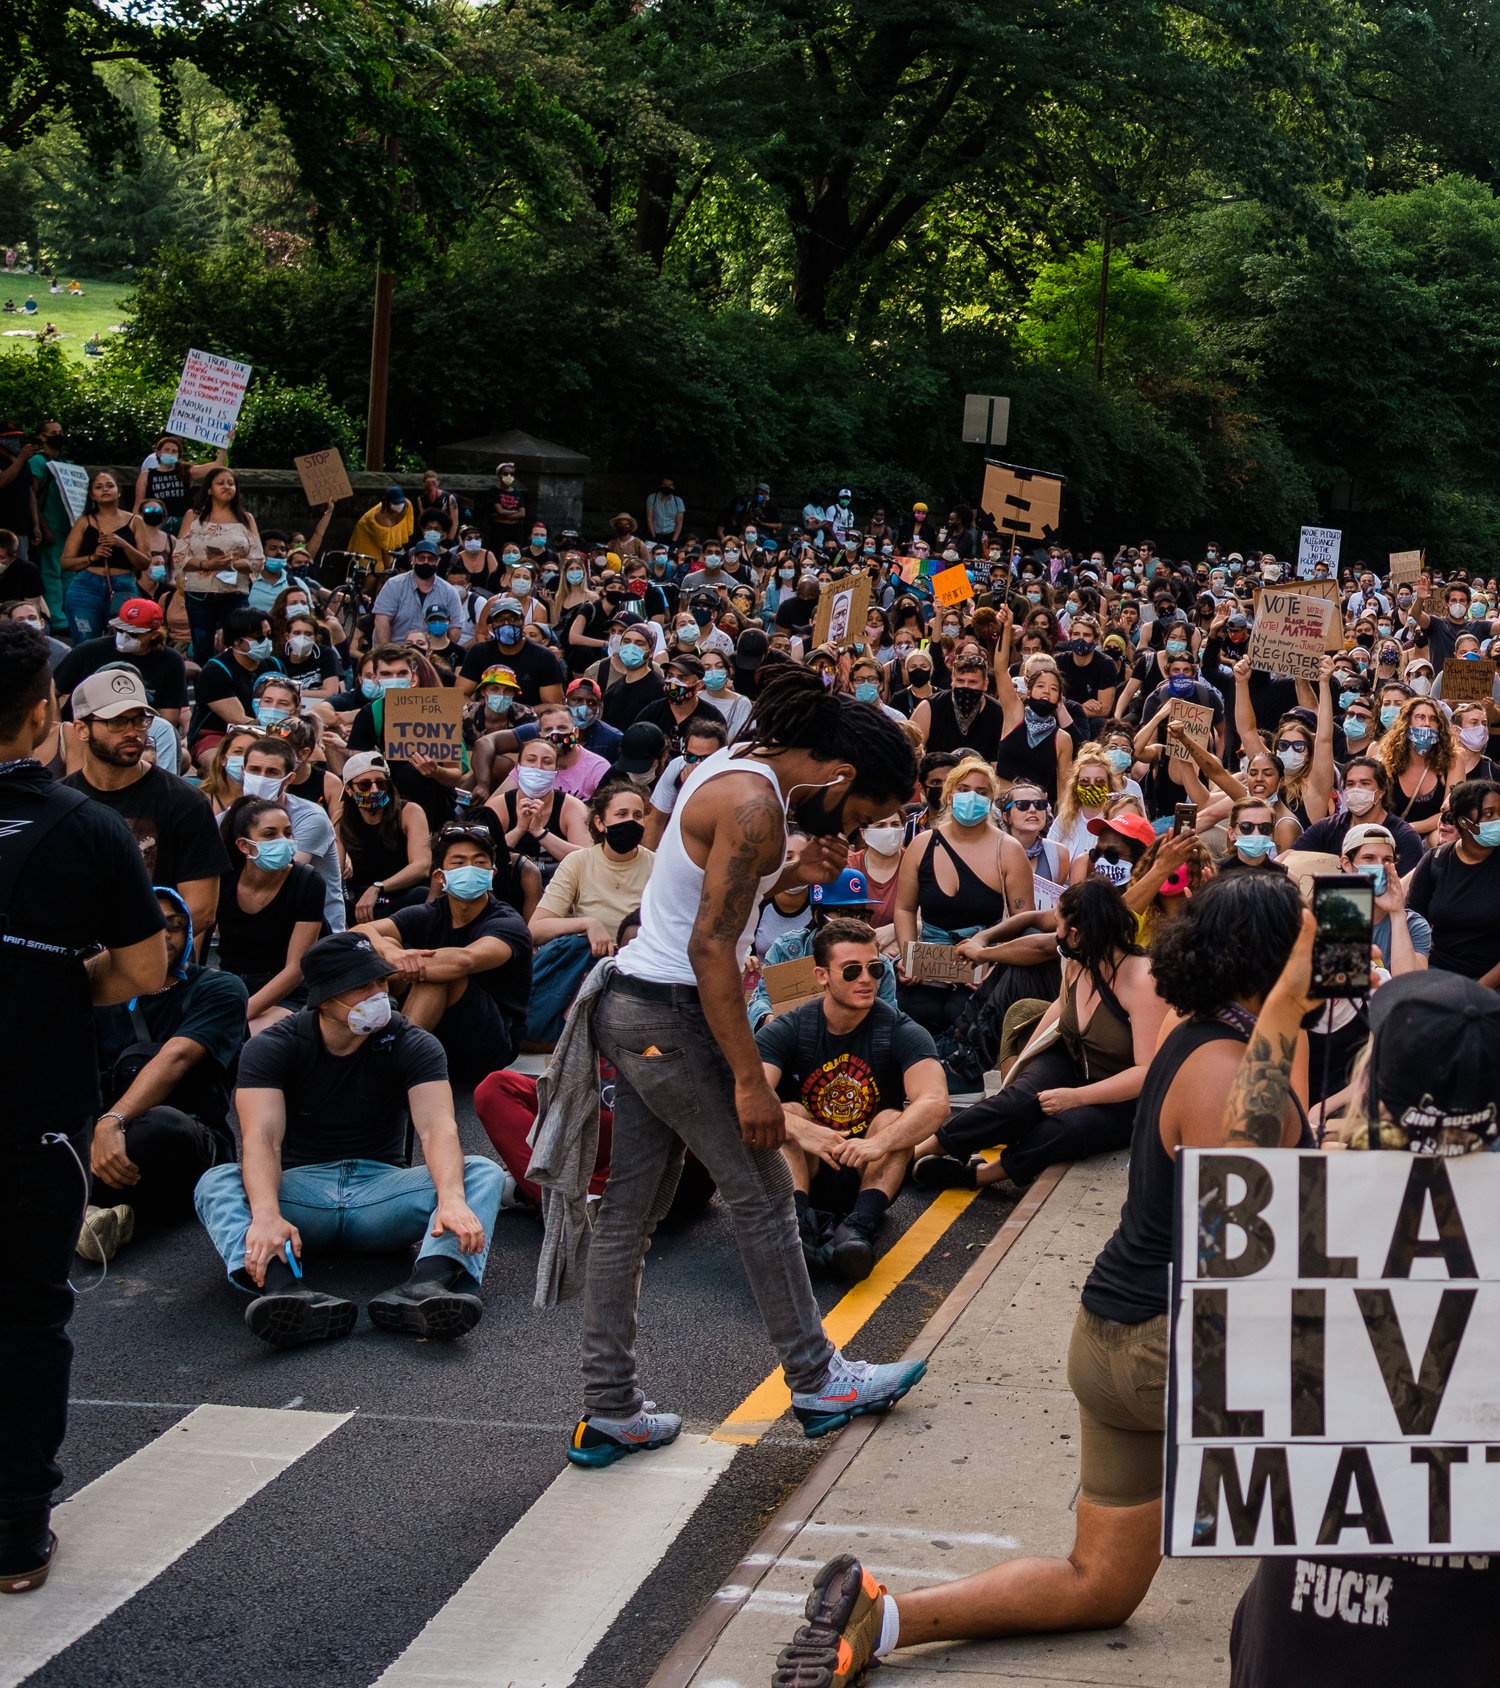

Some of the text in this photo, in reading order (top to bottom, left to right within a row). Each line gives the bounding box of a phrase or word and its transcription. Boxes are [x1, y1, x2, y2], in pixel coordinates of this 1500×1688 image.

[176, 397, 212, 415] ENOUGH
[170, 420, 226, 443] THE POLICE
[304, 452, 330, 469] STOP
[1264, 594, 1300, 616] VOTE
[1258, 621, 1323, 639] VOTE! MATTER
[1252, 633, 1268, 647] NY
[1252, 646, 1319, 669] REGISTER
[393, 695, 438, 706] JUSTICE
[421, 704, 442, 714] FOR
[1173, 702, 1205, 722] FUCK
[393, 722, 457, 740] TONY
[388, 741, 463, 761] MCDADE
[1167, 743, 1191, 760] TRU
[1096, 864, 1126, 875] STICE
[850, 878, 861, 892] C
[2, 934, 26, 946] RAIN
[912, 944, 947, 961] BLACK
[921, 961, 972, 977] MATTER
[823, 1053, 849, 1072] GRACIE
[1291, 1559, 1394, 1628] FUCK
